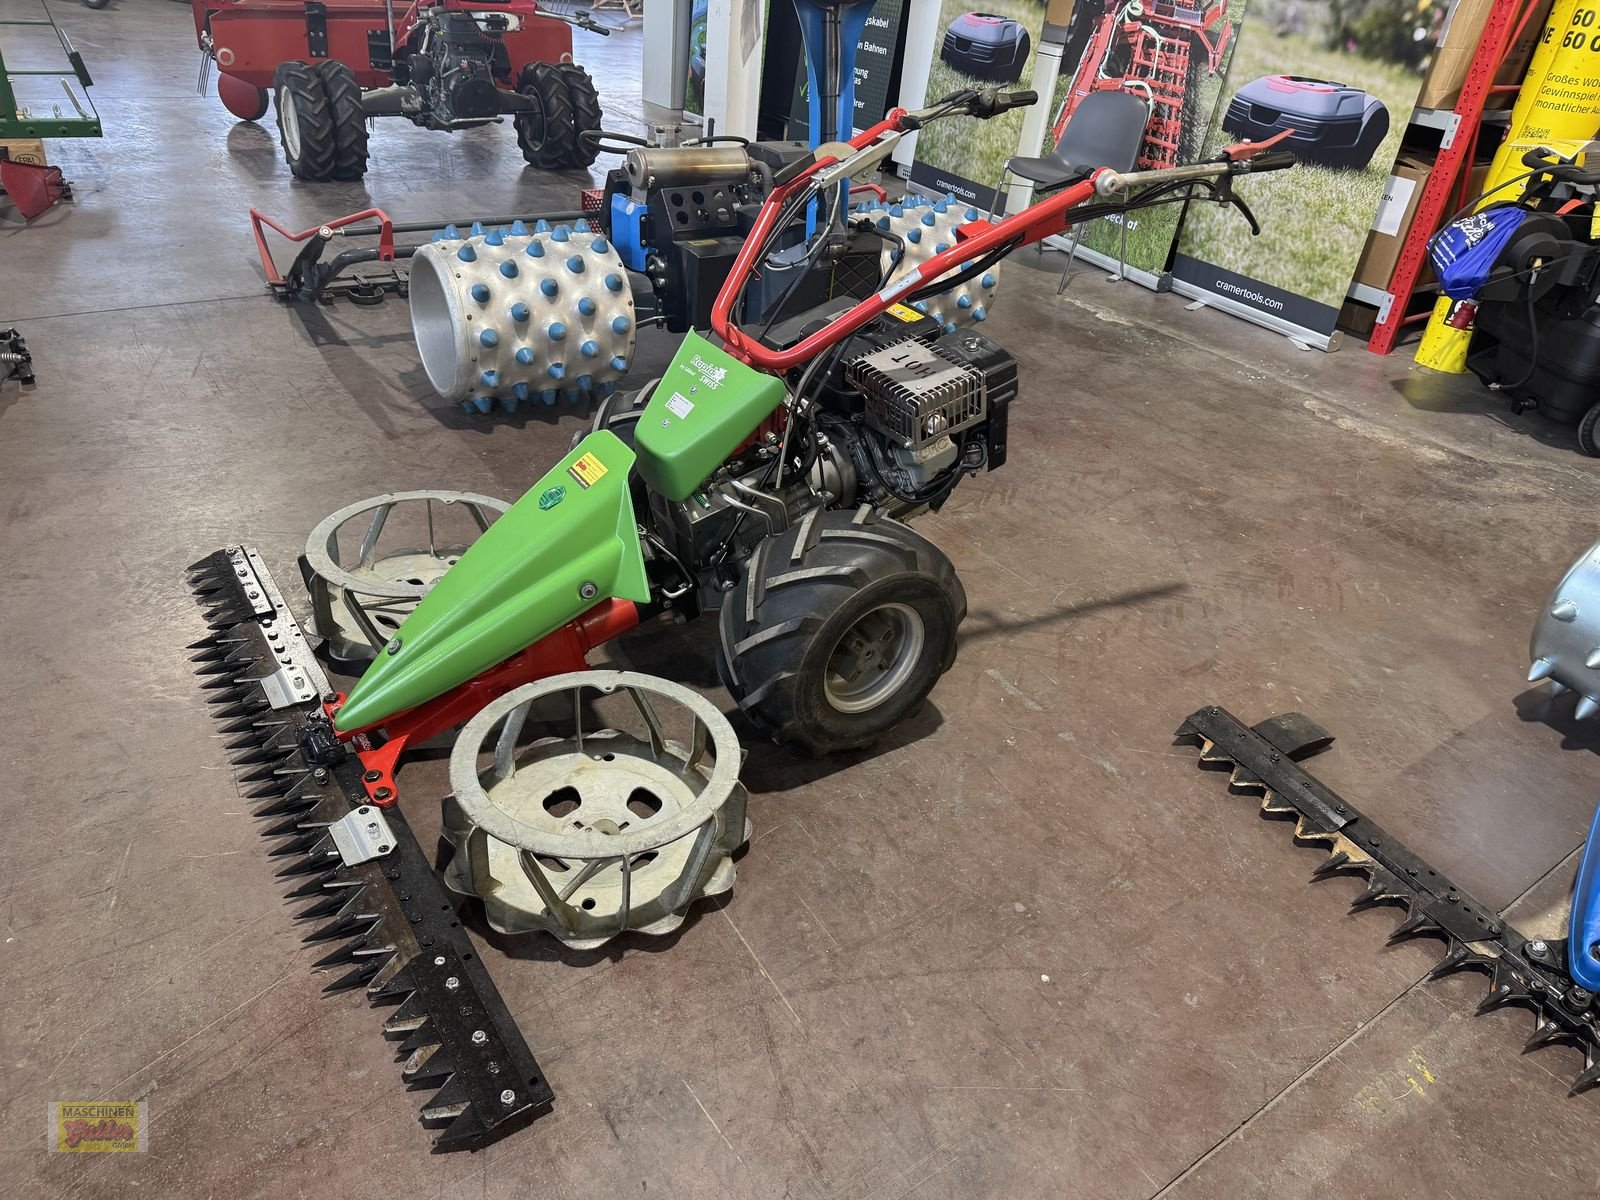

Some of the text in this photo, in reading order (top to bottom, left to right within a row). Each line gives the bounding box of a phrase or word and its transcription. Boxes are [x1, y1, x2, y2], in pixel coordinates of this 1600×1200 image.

[1572, 8, 1596, 27] 60
[863, 41, 887, 56] Bahnen
[1562, 30, 1586, 49] 60
[1546, 71, 1580, 86] Großes
[1540, 85, 1598, 101] Gewinnspiel
[1535, 99, 1591, 114] monatlicher
[936, 179, 976, 200] cramertools.com
[1215, 280, 1284, 311] cramertools.com
[690, 354, 717, 377] Rapid
[891, 354, 936, 379] HOT
[699, 375, 718, 390] SWISS
